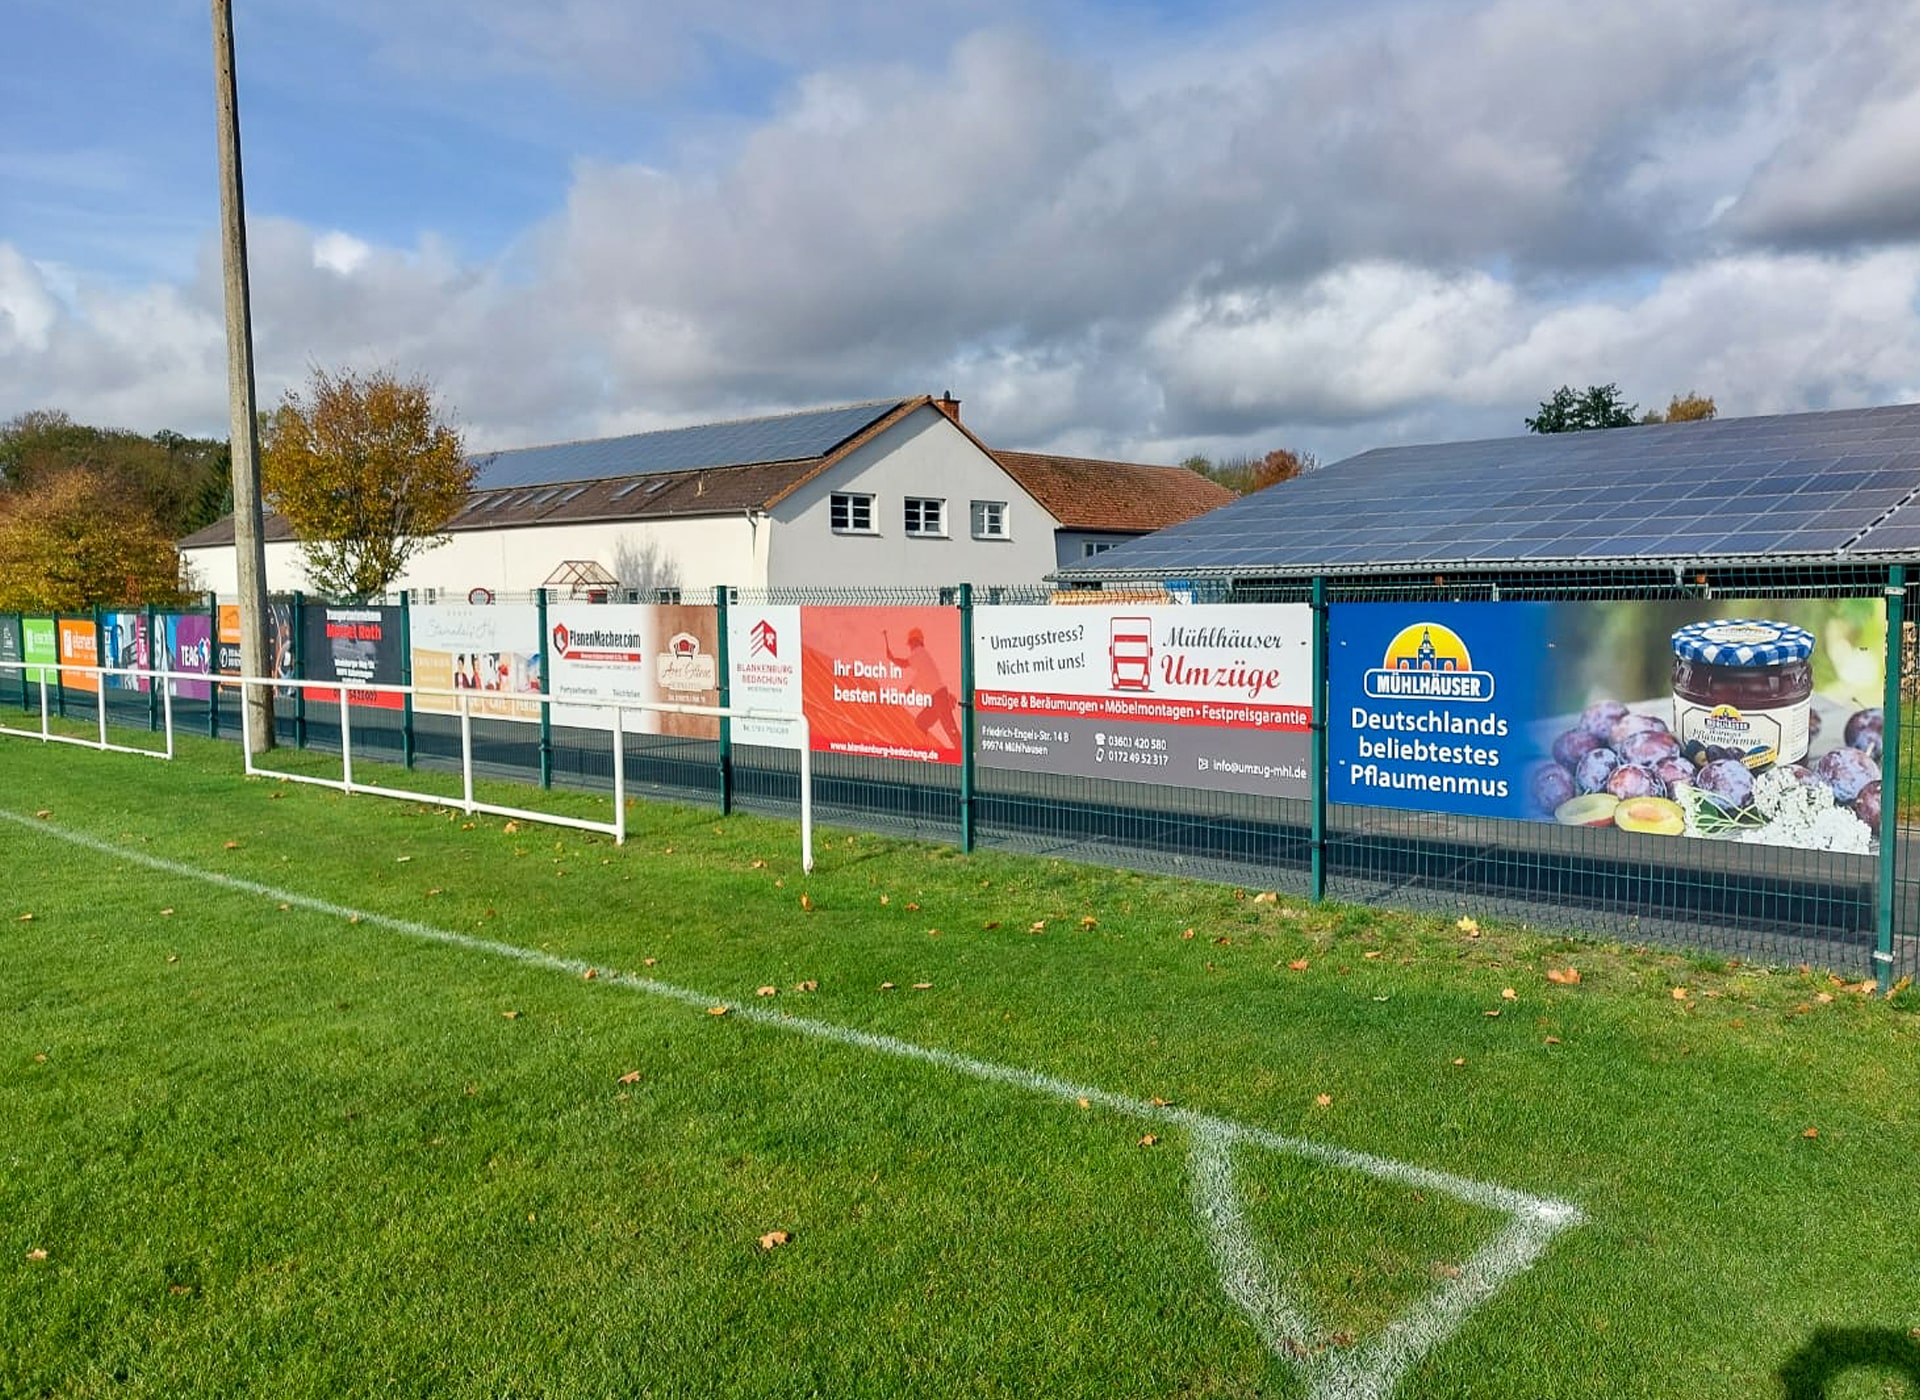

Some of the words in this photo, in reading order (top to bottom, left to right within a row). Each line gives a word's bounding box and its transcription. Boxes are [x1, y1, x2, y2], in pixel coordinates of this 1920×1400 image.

[358, 624, 382, 641] Roth
[569, 629, 641, 649] PlanenMacher.com
[990, 624, 1084, 650] Umzugsstress?
[1162, 626, 1282, 649] Mühlhäuser
[181, 645, 199, 667] TEAG
[996, 659, 1030, 676] Nicht
[1033, 656, 1055, 672] mit
[1057, 652, 1086, 670] uns!
[737, 663, 793, 674] BLANKENBURG
[833, 659, 851, 677] Ihr
[853, 660, 887, 679] Dach
[890, 661, 902, 679] in
[1161, 654, 1281, 699] Umzüge
[742, 674, 789, 685] BEDACHUNG
[1376, 672, 1481, 697] MÜHLHÄUSER
[833, 684, 877, 703] besten
[880, 687, 932, 707] Händen
[981, 693, 1018, 710] Umzüge
[1020, 695, 1028, 708] &
[1029, 695, 1098, 715] Beräumungen
[1104, 700, 1195, 720] Möbelmontagen
[1202, 706, 1307, 726] Festpreisgarantie
[1351, 707, 1509, 737] Deutschlands
[982, 725, 1052, 742] Friedrich-Engels-Str.
[1063, 732, 1070, 743] B
[1108, 735, 1132, 748] 03601
[1134, 737, 1150, 749] 420
[1150, 739, 1167, 750] 580
[830, 742, 939, 761] www.blankenburg-bedachung.de
[1004, 741, 1048, 755] Mühlhausen
[1108, 750, 1129, 763] 0172
[1128, 752, 1140, 764] 49
[1140, 753, 1153, 765] 52
[1153, 754, 1169, 766] 317
[1359, 735, 1500, 766] beliebtestes
[1213, 759, 1308, 780] info@umzug-mhl.de
[1350, 764, 1509, 797] Pflaumenmus
